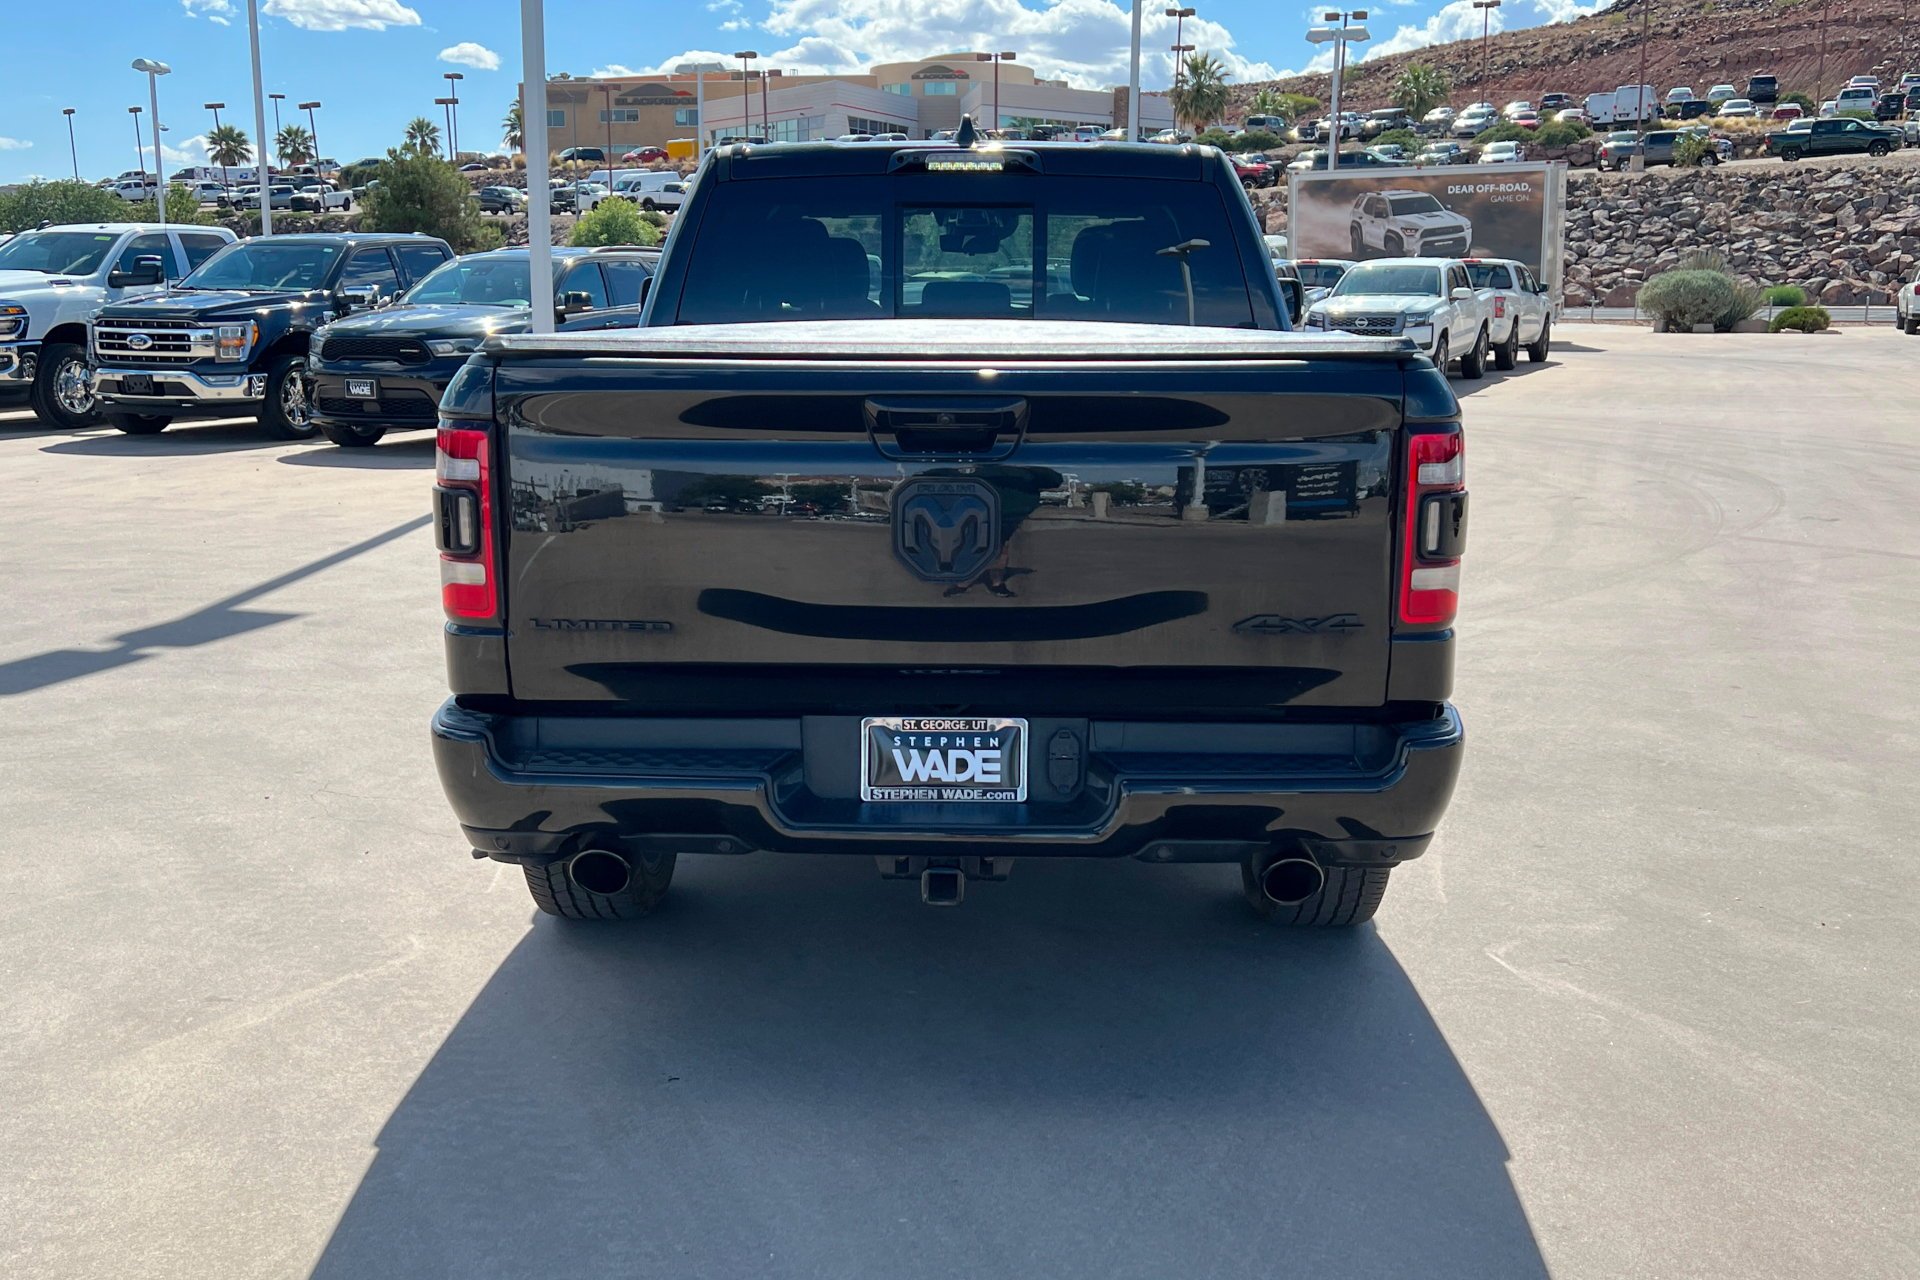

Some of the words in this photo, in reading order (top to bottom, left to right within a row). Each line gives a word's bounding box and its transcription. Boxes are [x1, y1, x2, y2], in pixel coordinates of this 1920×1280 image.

[1447, 184, 1474, 194] DEAR
[1475, 183, 1532, 193] OFF-ROAD,
[1490, 195, 1514, 203] GAME
[350, 385, 371, 395] WADE
[529, 618, 672, 632] LIMITED
[903, 719, 918, 730] ST.
[920, 719, 969, 732] GEORGE,
[972, 719, 987, 730] UT
[893, 736, 999, 747] STEPHEN
[892, 748, 1001, 783] WADE
[872, 788, 938, 800] STEPHEN
[941, 788, 1015, 800] WADE.com
